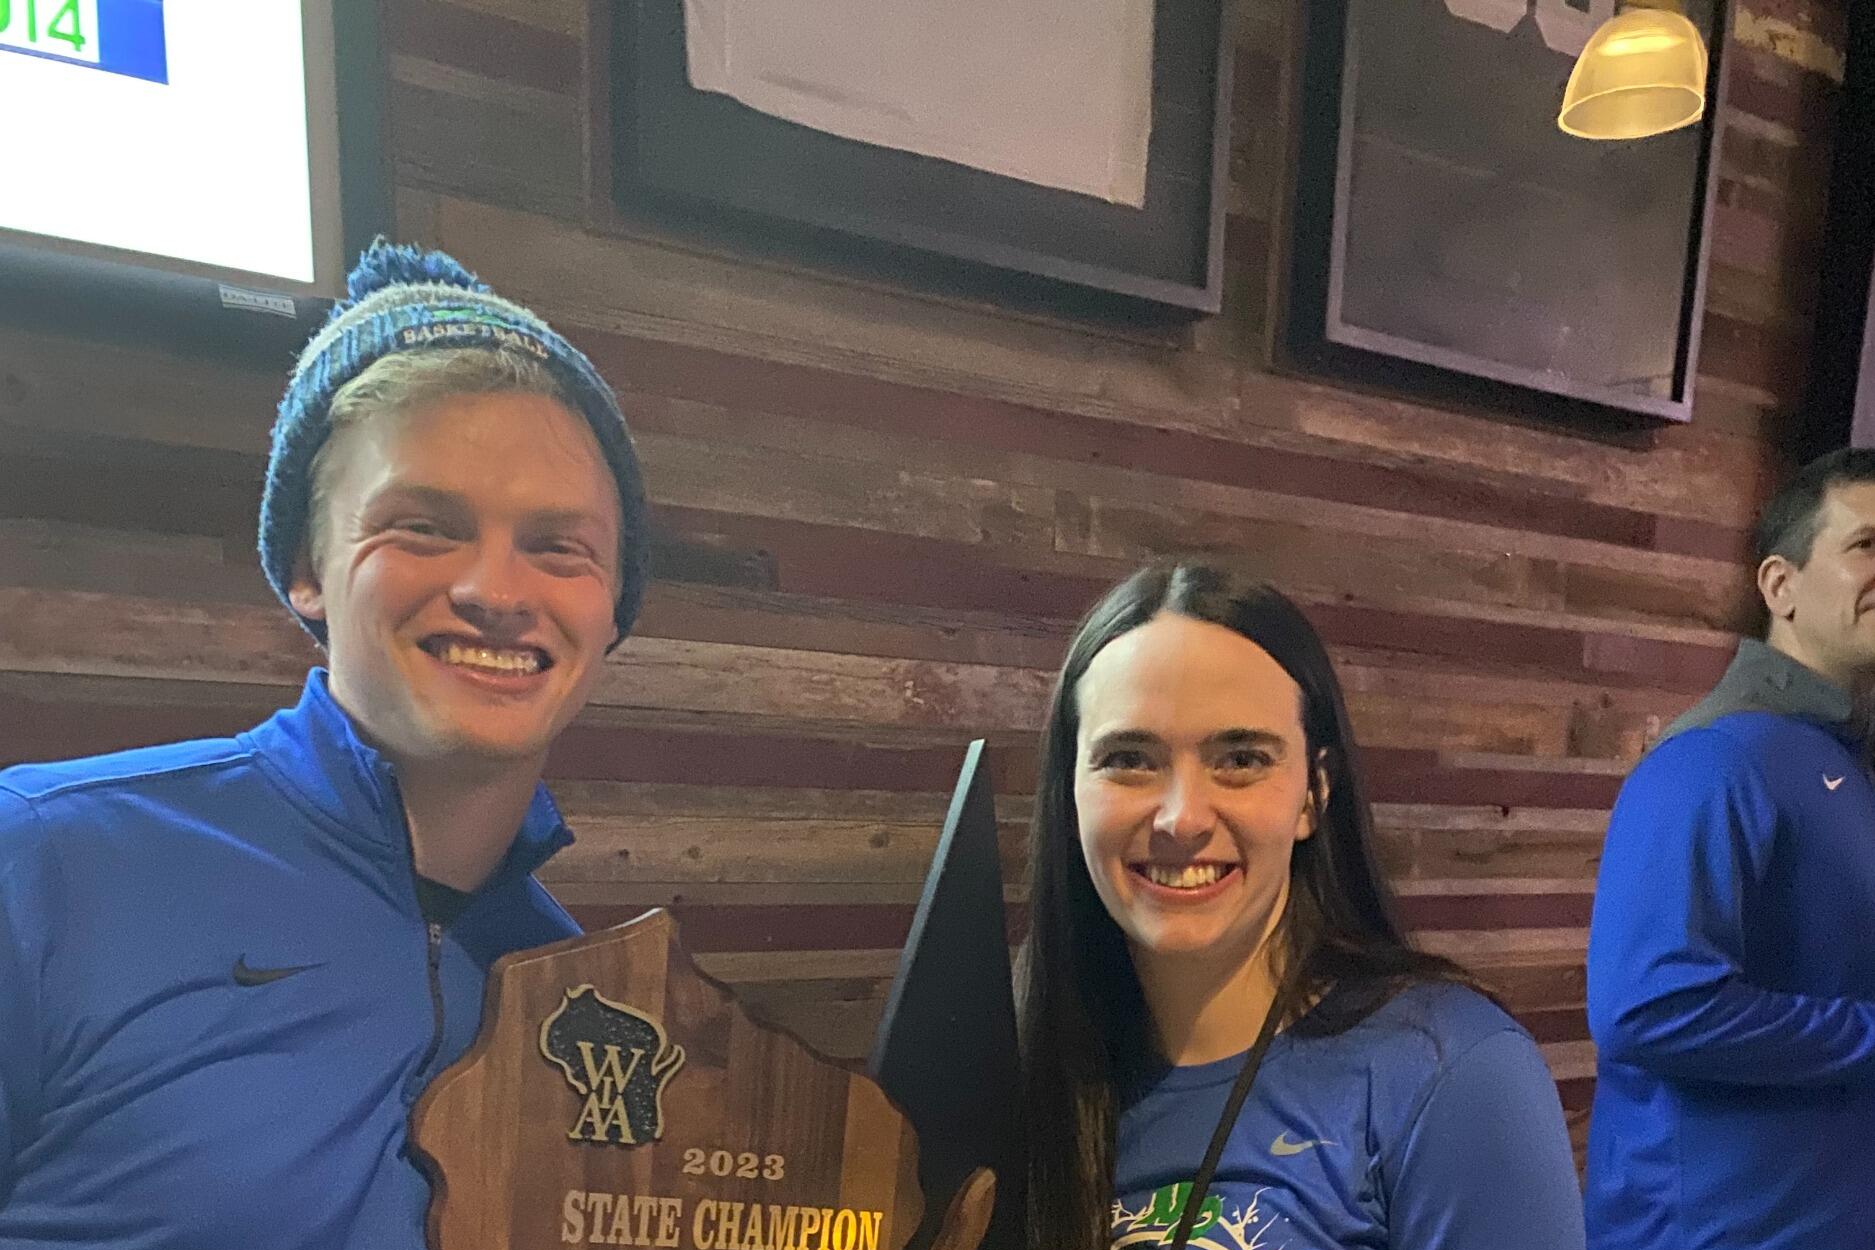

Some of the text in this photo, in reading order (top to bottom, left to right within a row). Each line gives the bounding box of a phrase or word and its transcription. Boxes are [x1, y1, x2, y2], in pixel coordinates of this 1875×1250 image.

[0, 0, 86, 51] 14
[403, 324, 549, 359] BASKETBALL
[682, 1148, 785, 1180] 2023
[561, 1190, 682, 1247] STATE
